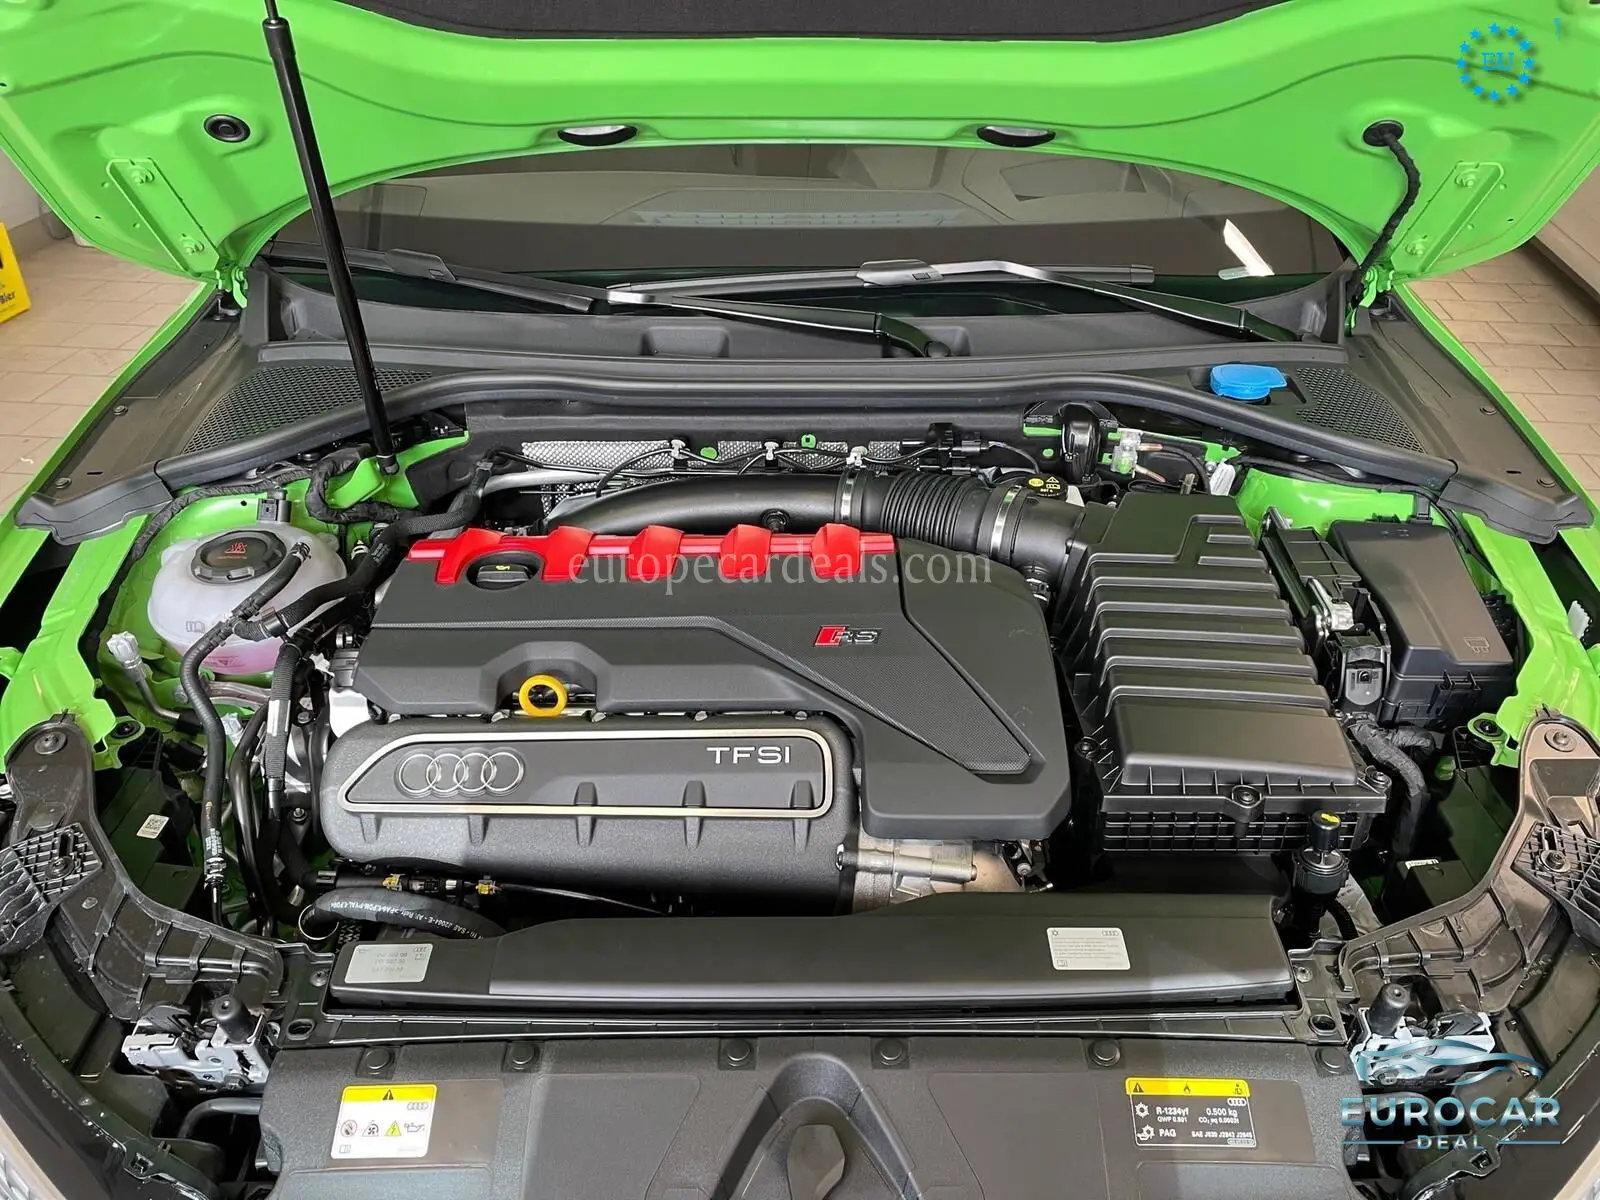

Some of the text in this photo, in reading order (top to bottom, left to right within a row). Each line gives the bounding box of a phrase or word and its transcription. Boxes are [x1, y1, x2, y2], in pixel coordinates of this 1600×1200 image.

[822, 627, 879, 645] RS
[706, 746, 790, 764] TFSI
[1155, 1106, 1238, 1117] R-1234yf 0.500 kg
[1159, 1128, 1177, 1137] PAG
